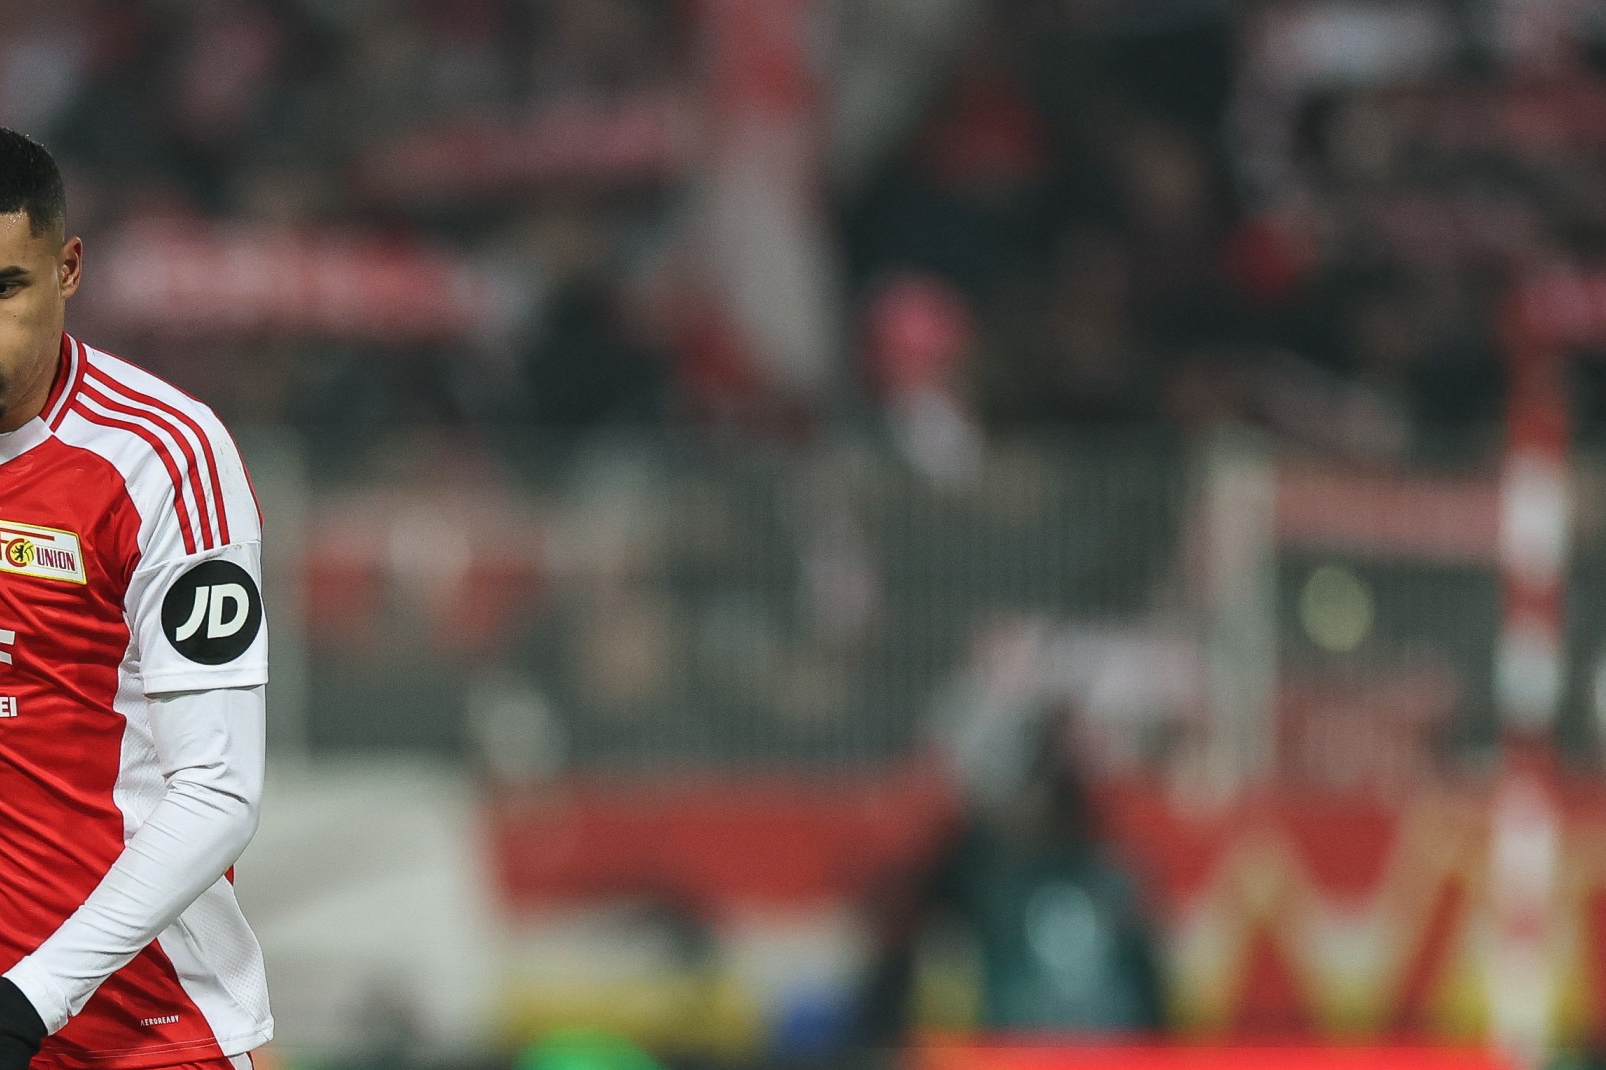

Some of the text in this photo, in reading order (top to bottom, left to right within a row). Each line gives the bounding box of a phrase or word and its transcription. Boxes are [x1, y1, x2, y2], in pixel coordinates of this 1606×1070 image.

[36, 546, 76, 572] UNION
[176, 583, 250, 642] JD
[140, 1014, 179, 1026] AEROREADY
